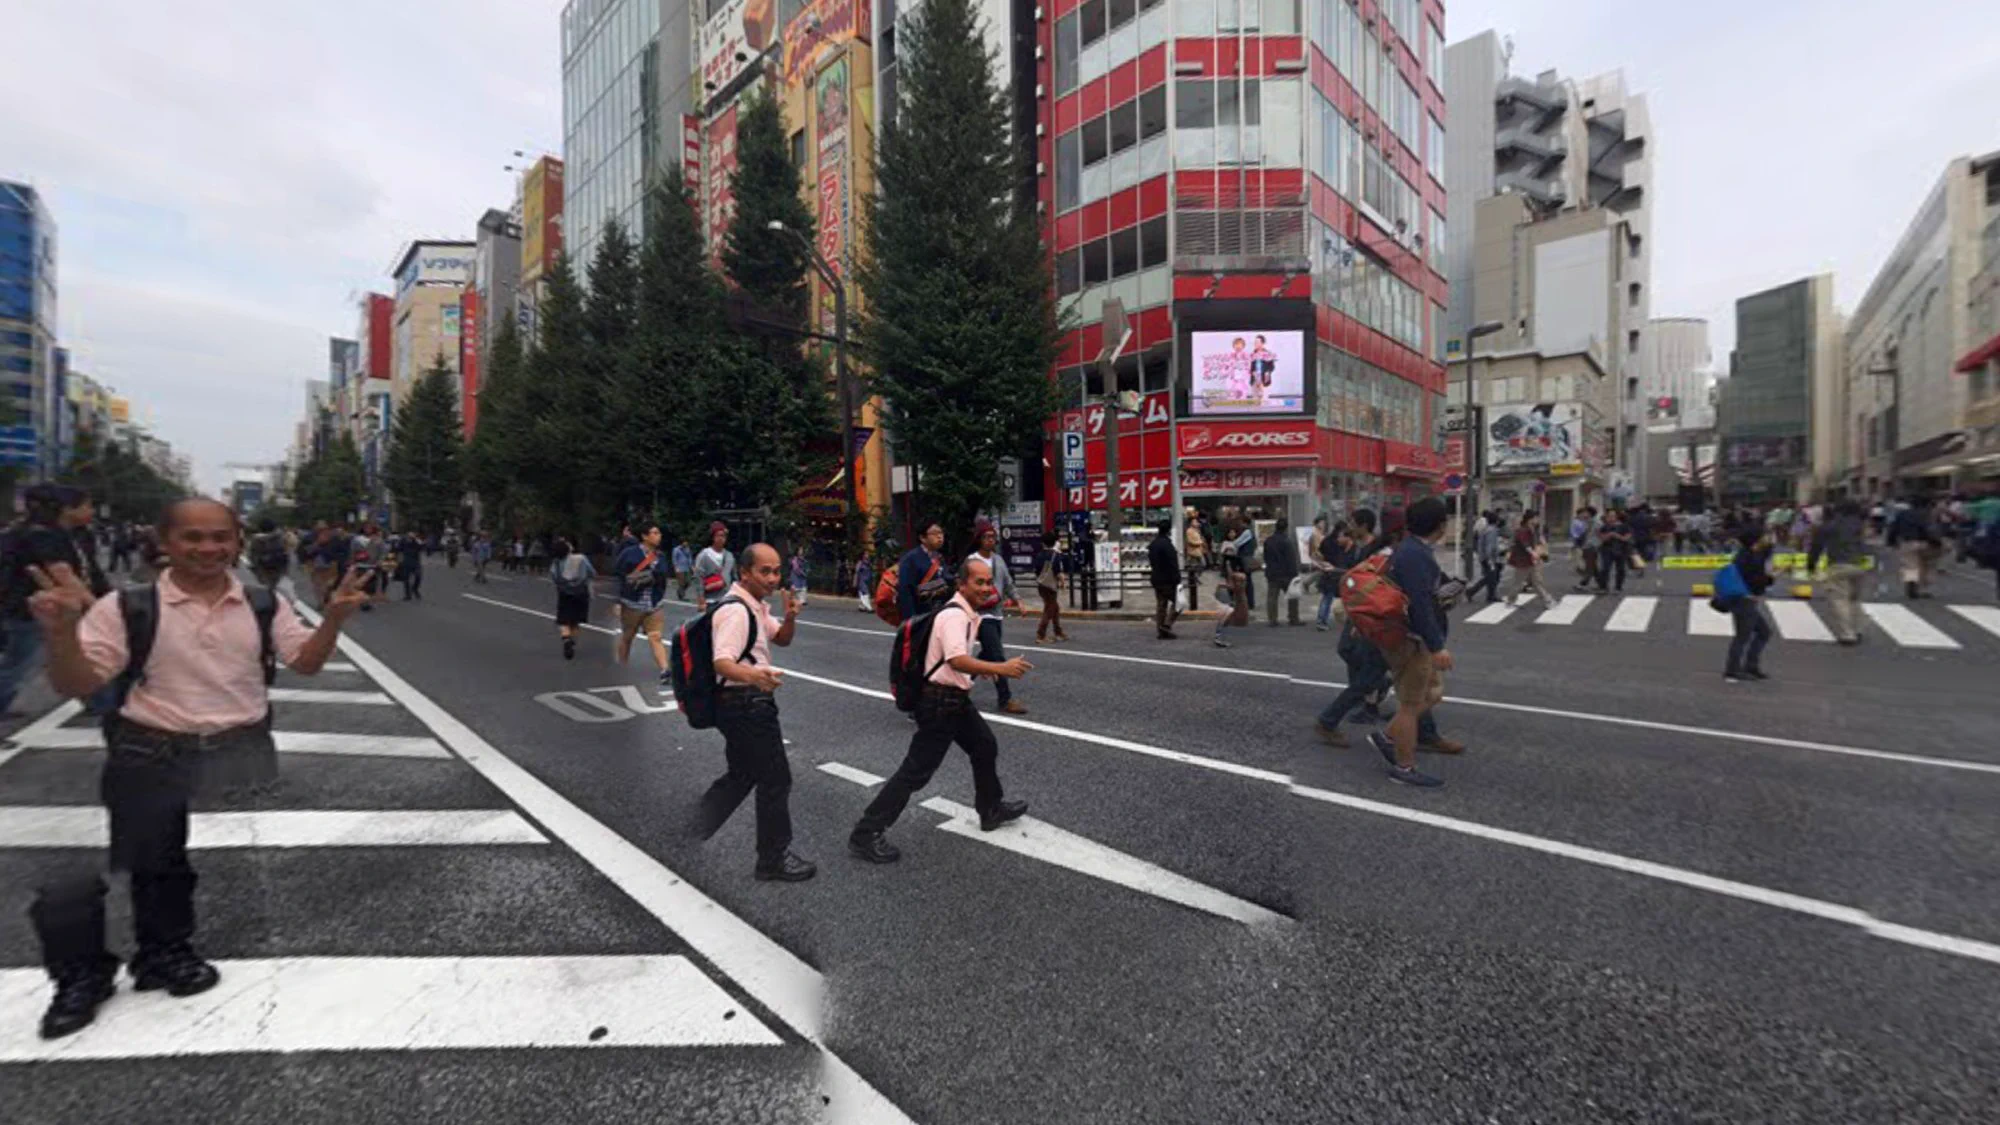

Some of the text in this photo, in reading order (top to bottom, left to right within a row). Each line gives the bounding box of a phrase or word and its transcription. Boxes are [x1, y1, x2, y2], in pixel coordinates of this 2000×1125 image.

[1088, 398, 1168, 435] ゲーム
[1066, 435, 1081, 456] P
[1216, 431, 1311, 447] ADORES
[1069, 476, 1169, 505] カラオケ
